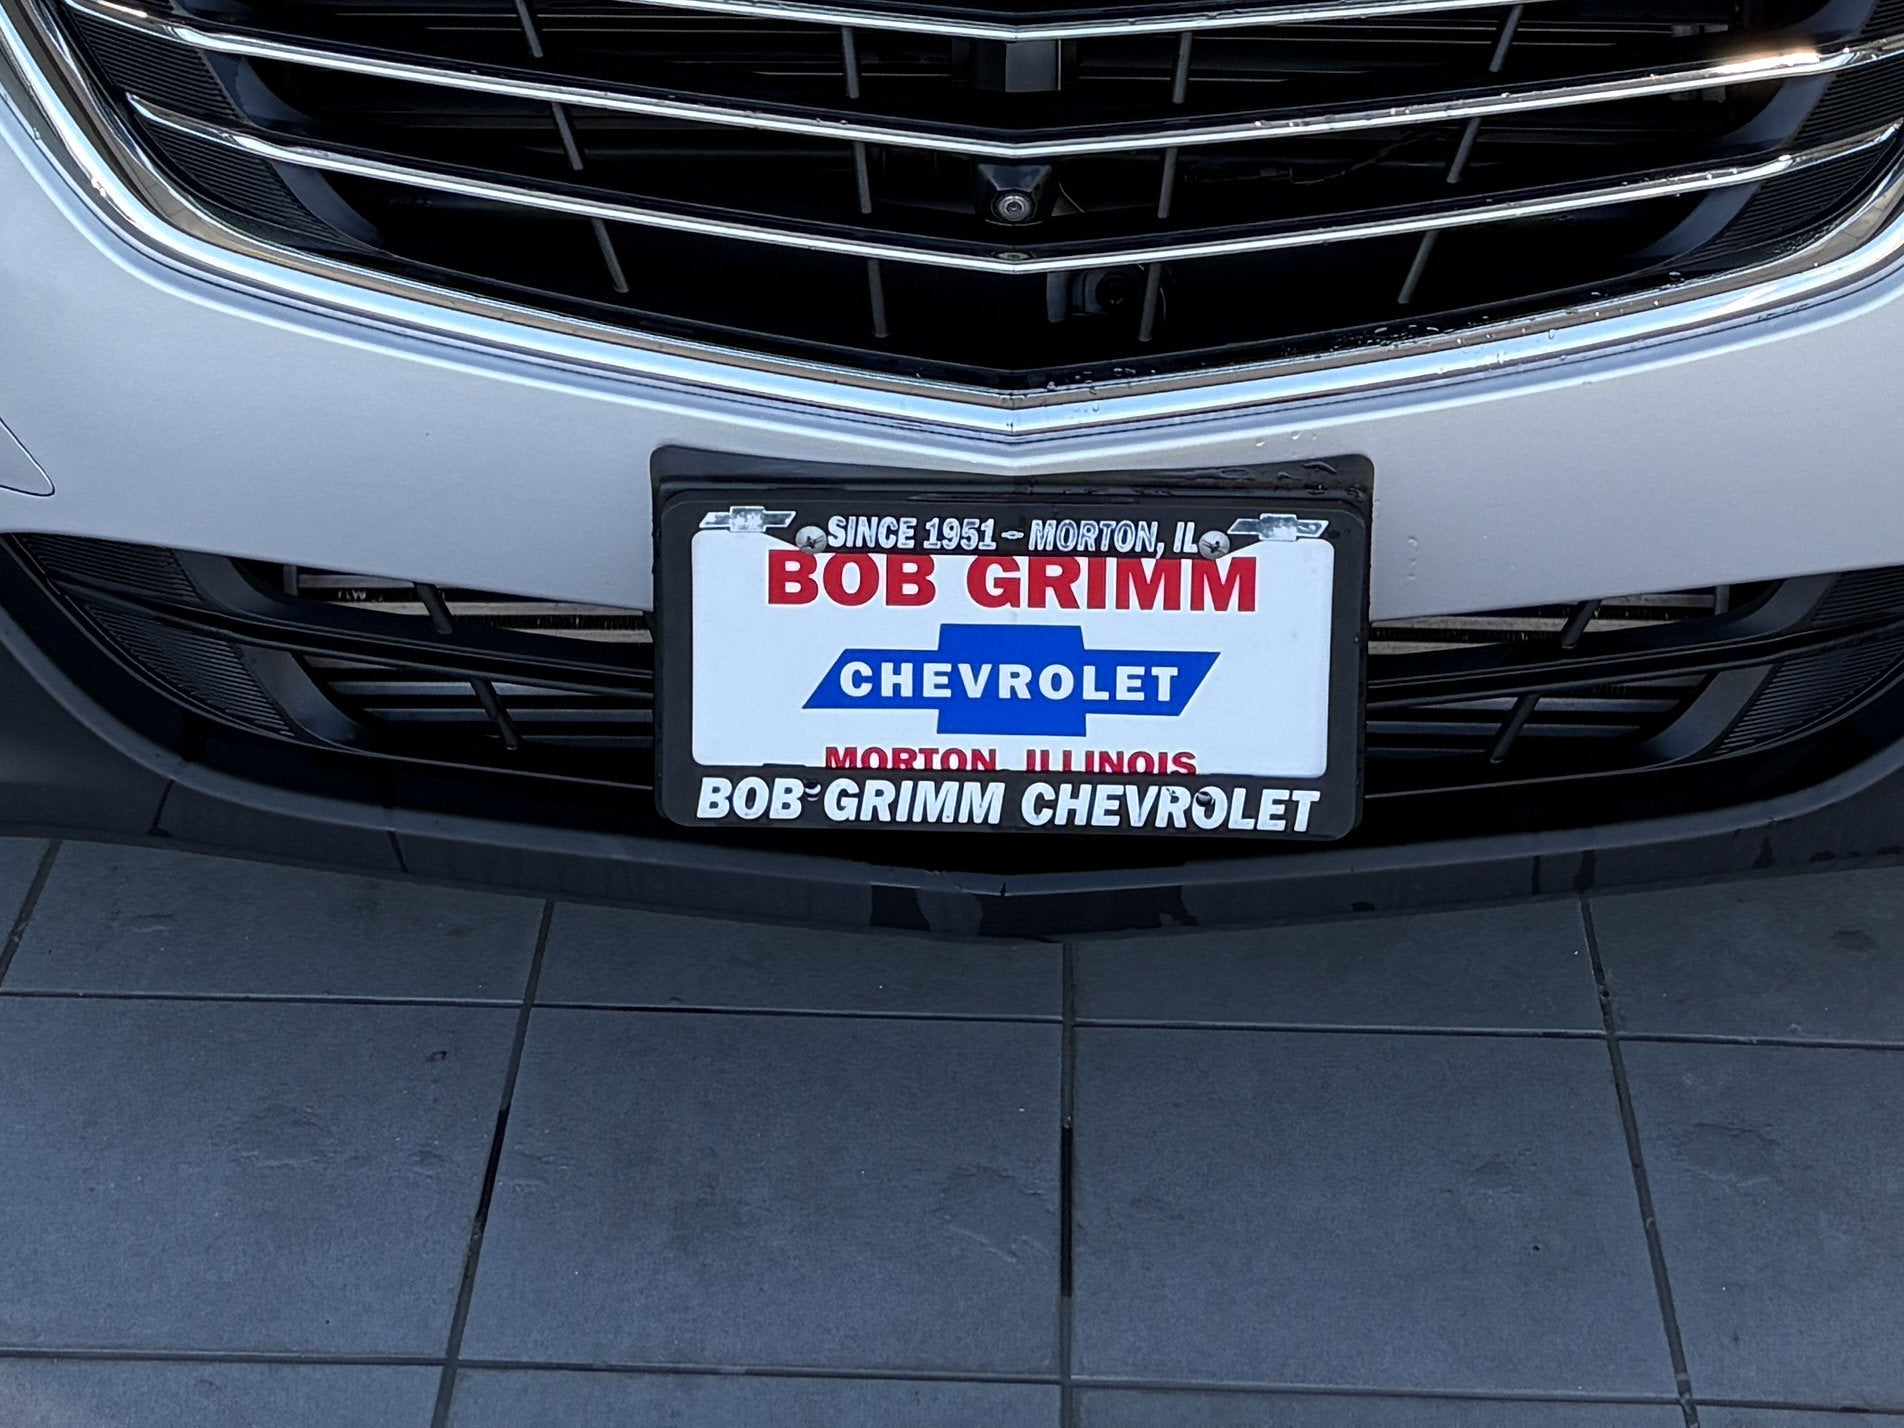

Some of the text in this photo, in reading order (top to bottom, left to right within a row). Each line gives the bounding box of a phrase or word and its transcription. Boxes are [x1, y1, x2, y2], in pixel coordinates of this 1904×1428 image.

[827, 515, 1199, 559] SINCE 1951 MORTON, IL
[767, 549, 1256, 613] BOB GRIMM
[838, 659, 1180, 703] CHEVROLET
[824, 746, 998, 772] MORTON
[696, 776, 1322, 833] BOB GRIMM CHEVROLET
